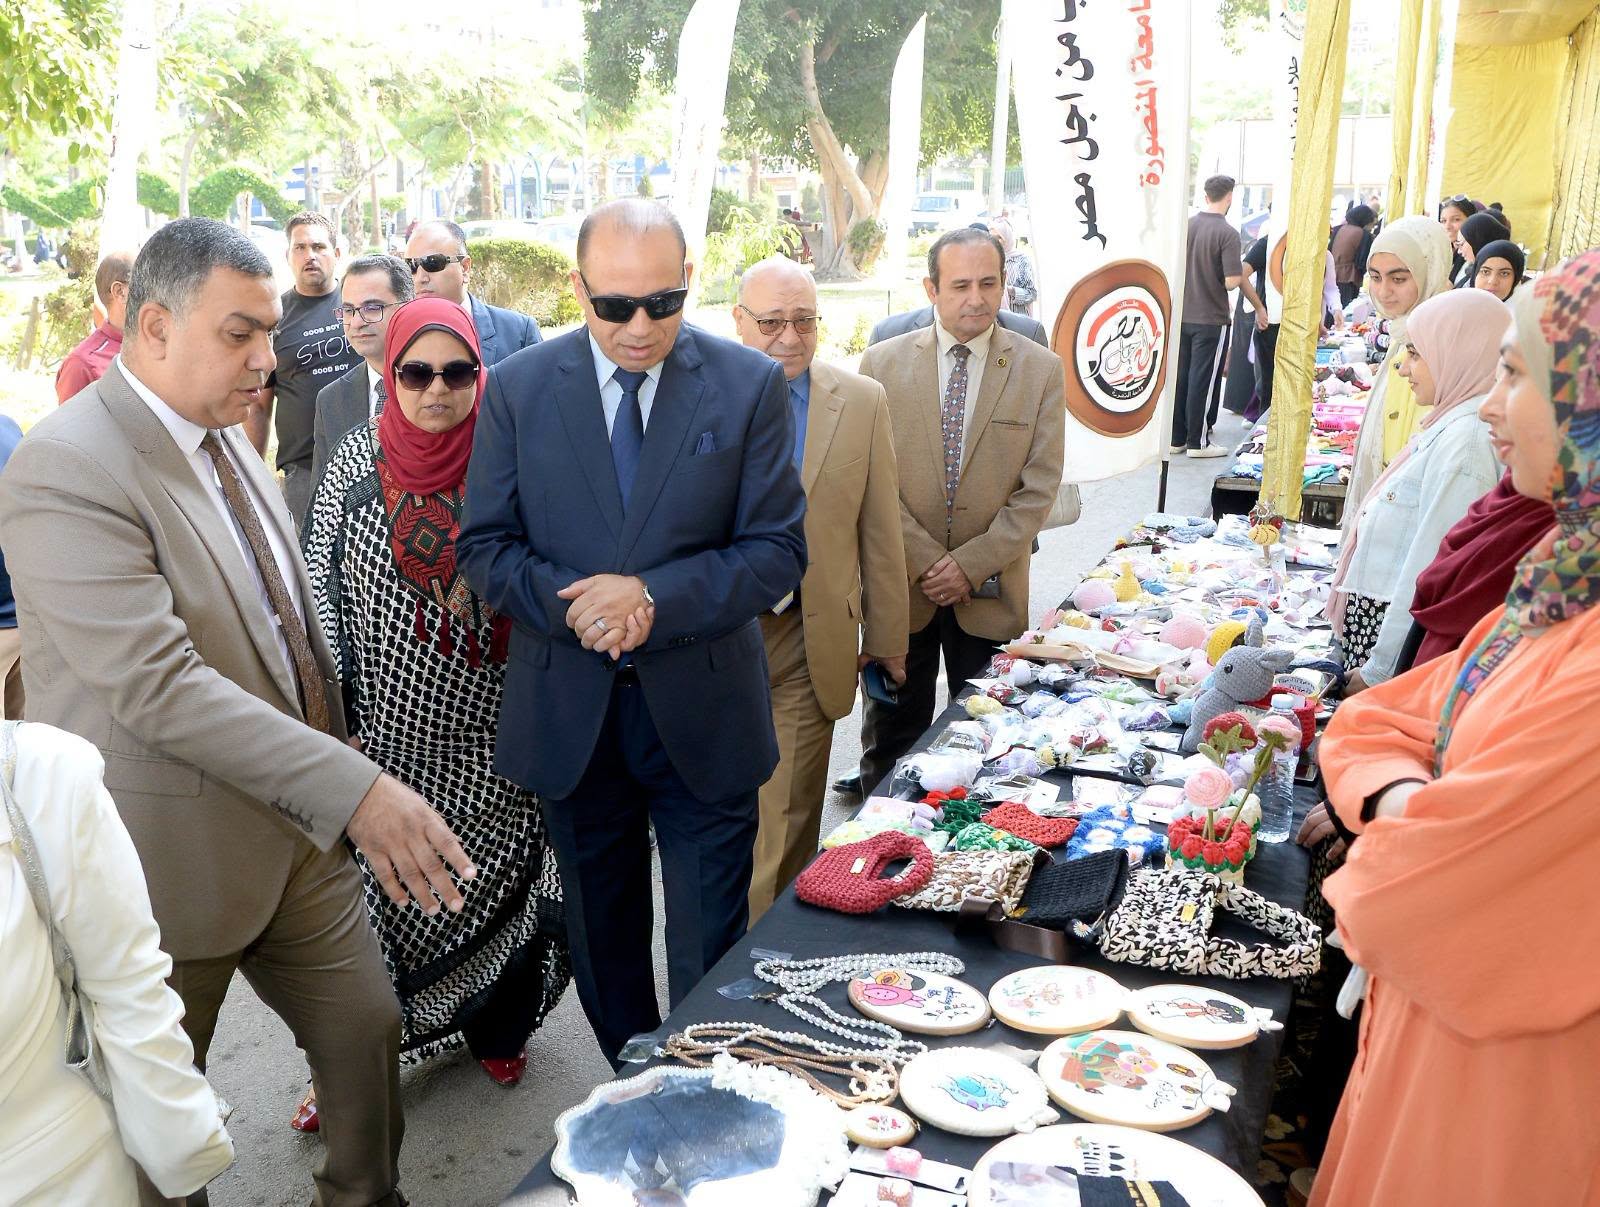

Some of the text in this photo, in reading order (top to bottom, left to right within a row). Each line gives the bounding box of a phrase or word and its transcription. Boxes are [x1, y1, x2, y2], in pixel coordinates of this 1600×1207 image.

[1055, 32, 1094, 81] من
[1127, 0, 1154, 73] امعة
[1135, 80, 1165, 188] المنصورة
[1073, 172, 1107, 251] مصر
[303, 323, 340, 337] GOOD BOY
[312, 363, 349, 375] GOOD BOY
